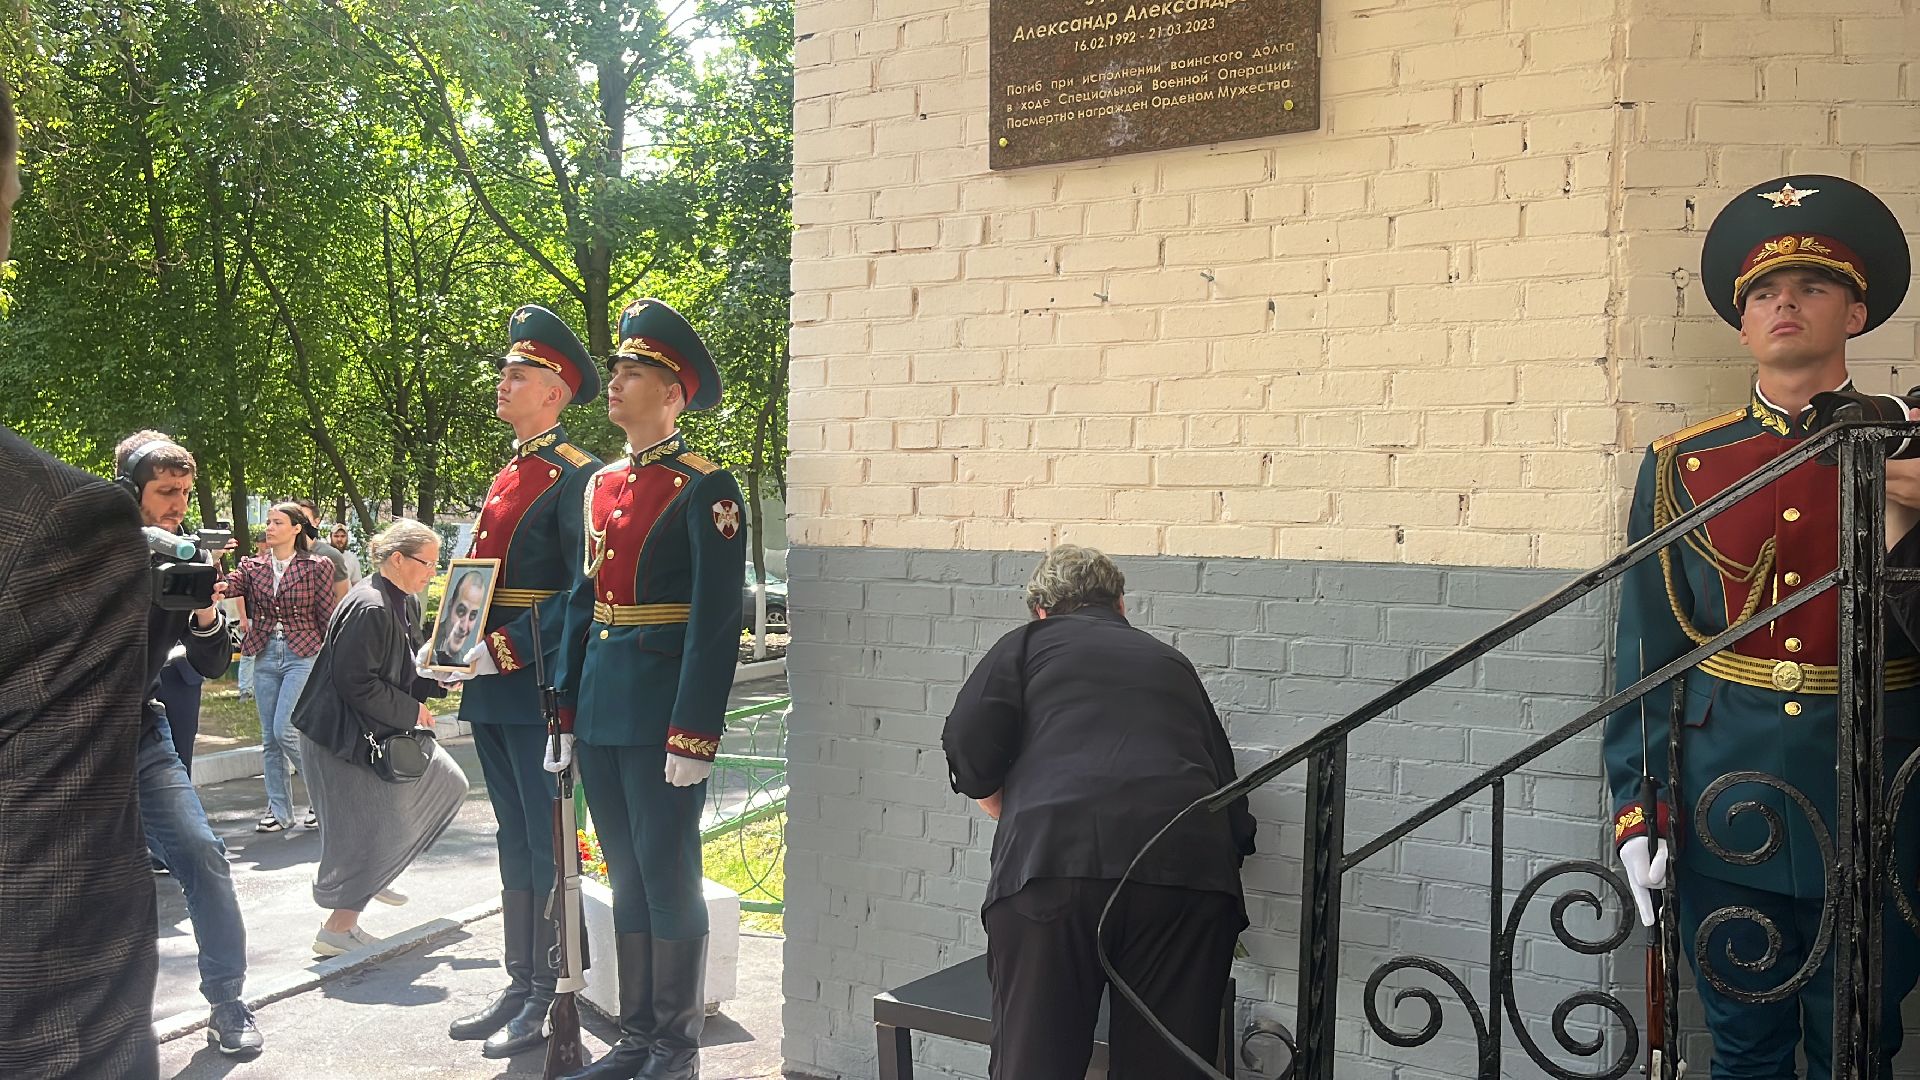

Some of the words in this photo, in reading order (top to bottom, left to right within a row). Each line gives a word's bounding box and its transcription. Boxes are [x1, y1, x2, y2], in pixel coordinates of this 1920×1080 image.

[1013, 12, 1117, 42] Александр
[1124, 0, 1246, 22] Александ
[1074, 31, 1136, 52] 16.02.1992
[1149, 18, 1215, 39] 21.03.2023
[1007, 80, 1042, 97] Погиб
[1051, 77, 1074, 90] при
[1082, 63, 1161, 84] исполнении
[1170, 50, 1243, 70] воинского
[1252, 42, 1294, 59] долга
[1006, 104, 1013, 112] в
[1020, 98, 1050, 111] ходе
[1058, 80, 1143, 105] Специальной
[1152, 70, 1208, 91] Военной
[1006, 111, 1074, 129] Посмертно
[1077, 99, 1148, 119] награжден
[1151, 90, 1214, 109] Орденом
[1217, 79, 1294, 100] Мужества.
